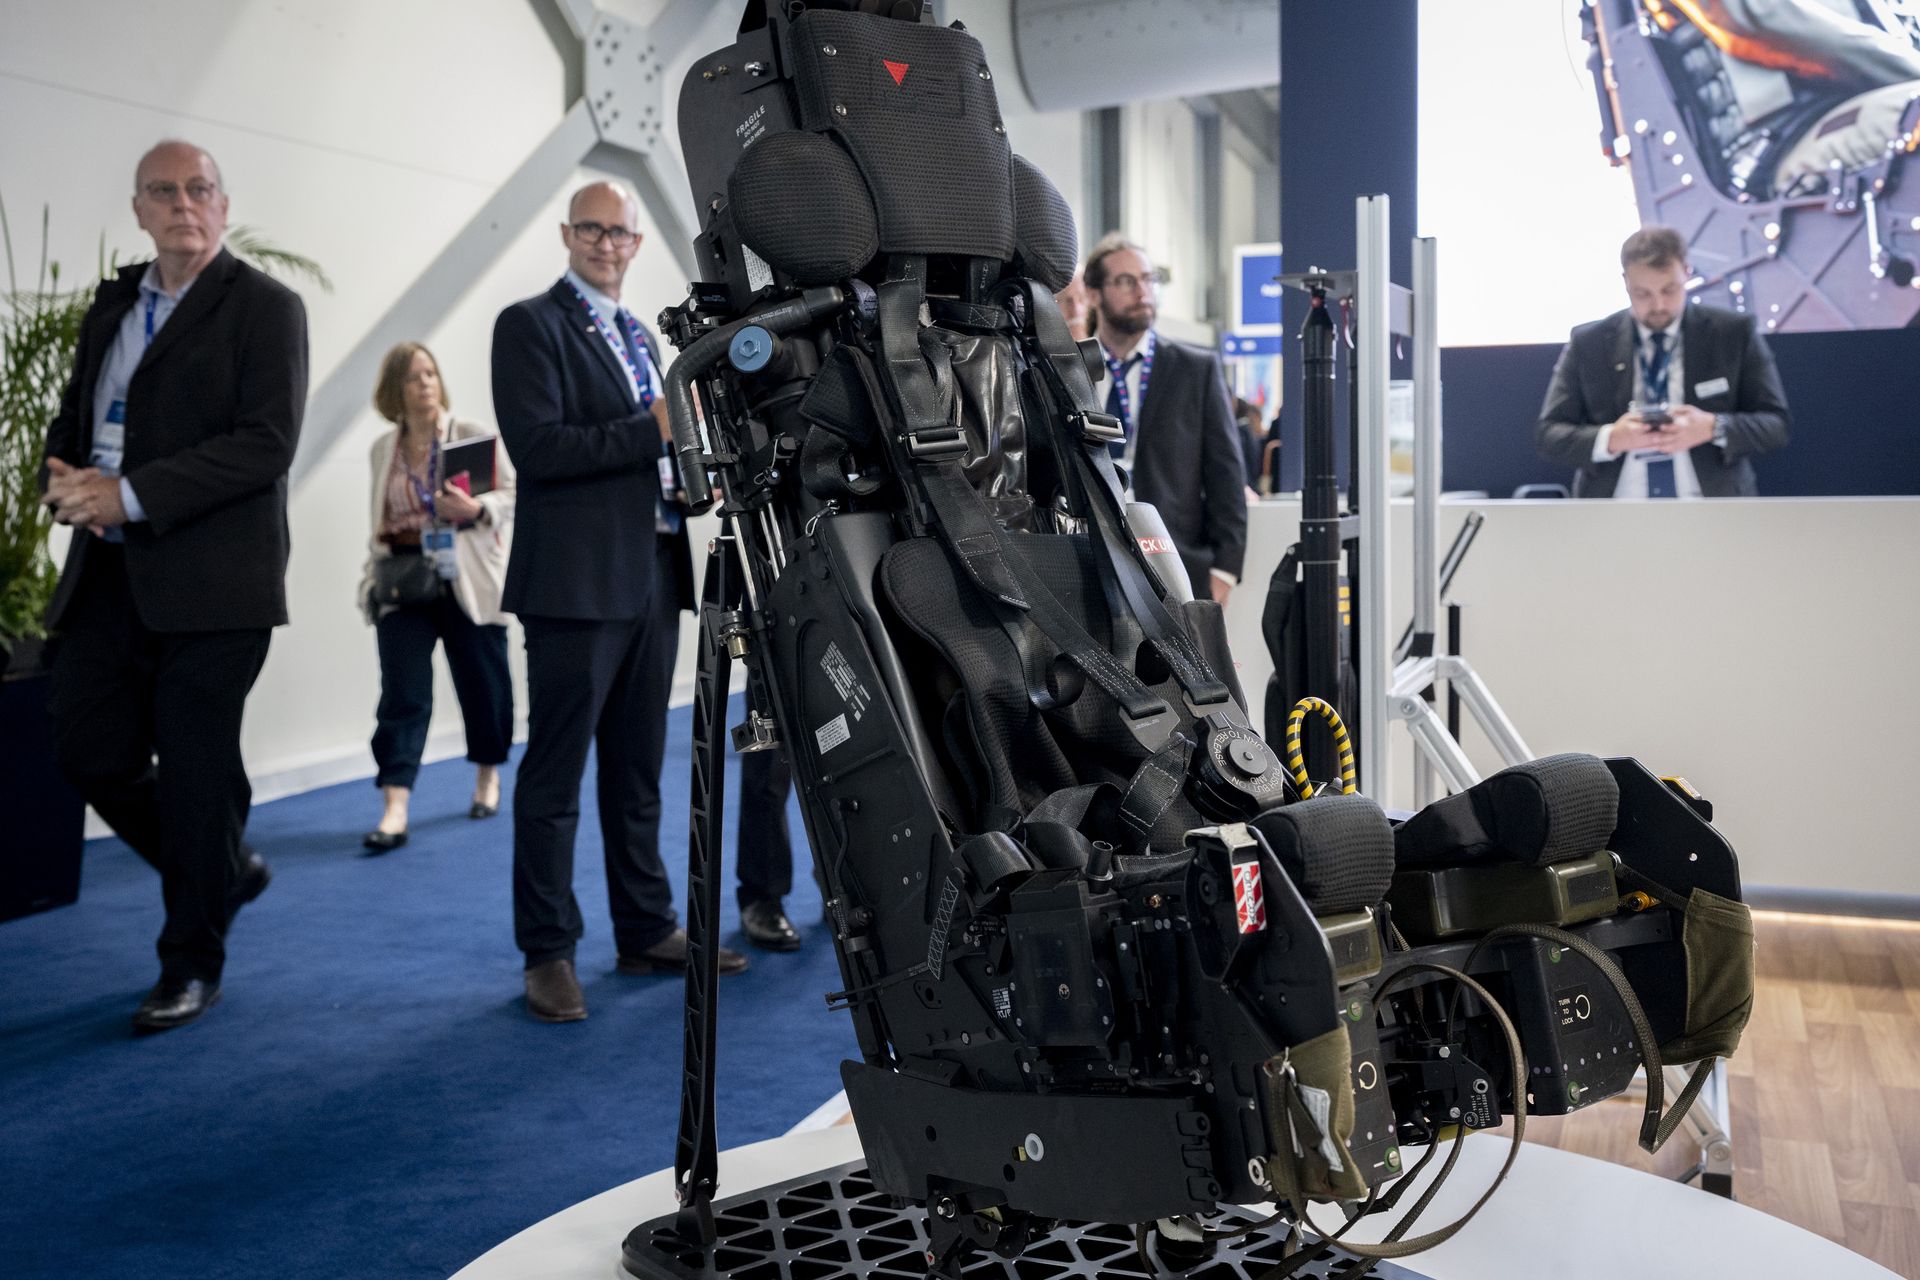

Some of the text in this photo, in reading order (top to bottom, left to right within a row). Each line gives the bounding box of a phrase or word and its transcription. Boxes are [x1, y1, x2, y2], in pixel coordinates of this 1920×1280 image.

[736, 105, 766, 137] FRAGILE
[744, 120, 760, 138] DO NOT
[1141, 539, 1159, 552] CK
[1228, 730, 1241, 739] TO
[1213, 731, 1229, 767] RELEASE
[1231, 767, 1281, 793] PUSH BUTON
[1250, 775, 1267, 785] AND
[1558, 998, 1571, 1006] TURN
[1561, 1017, 1574, 1026] LOCK
